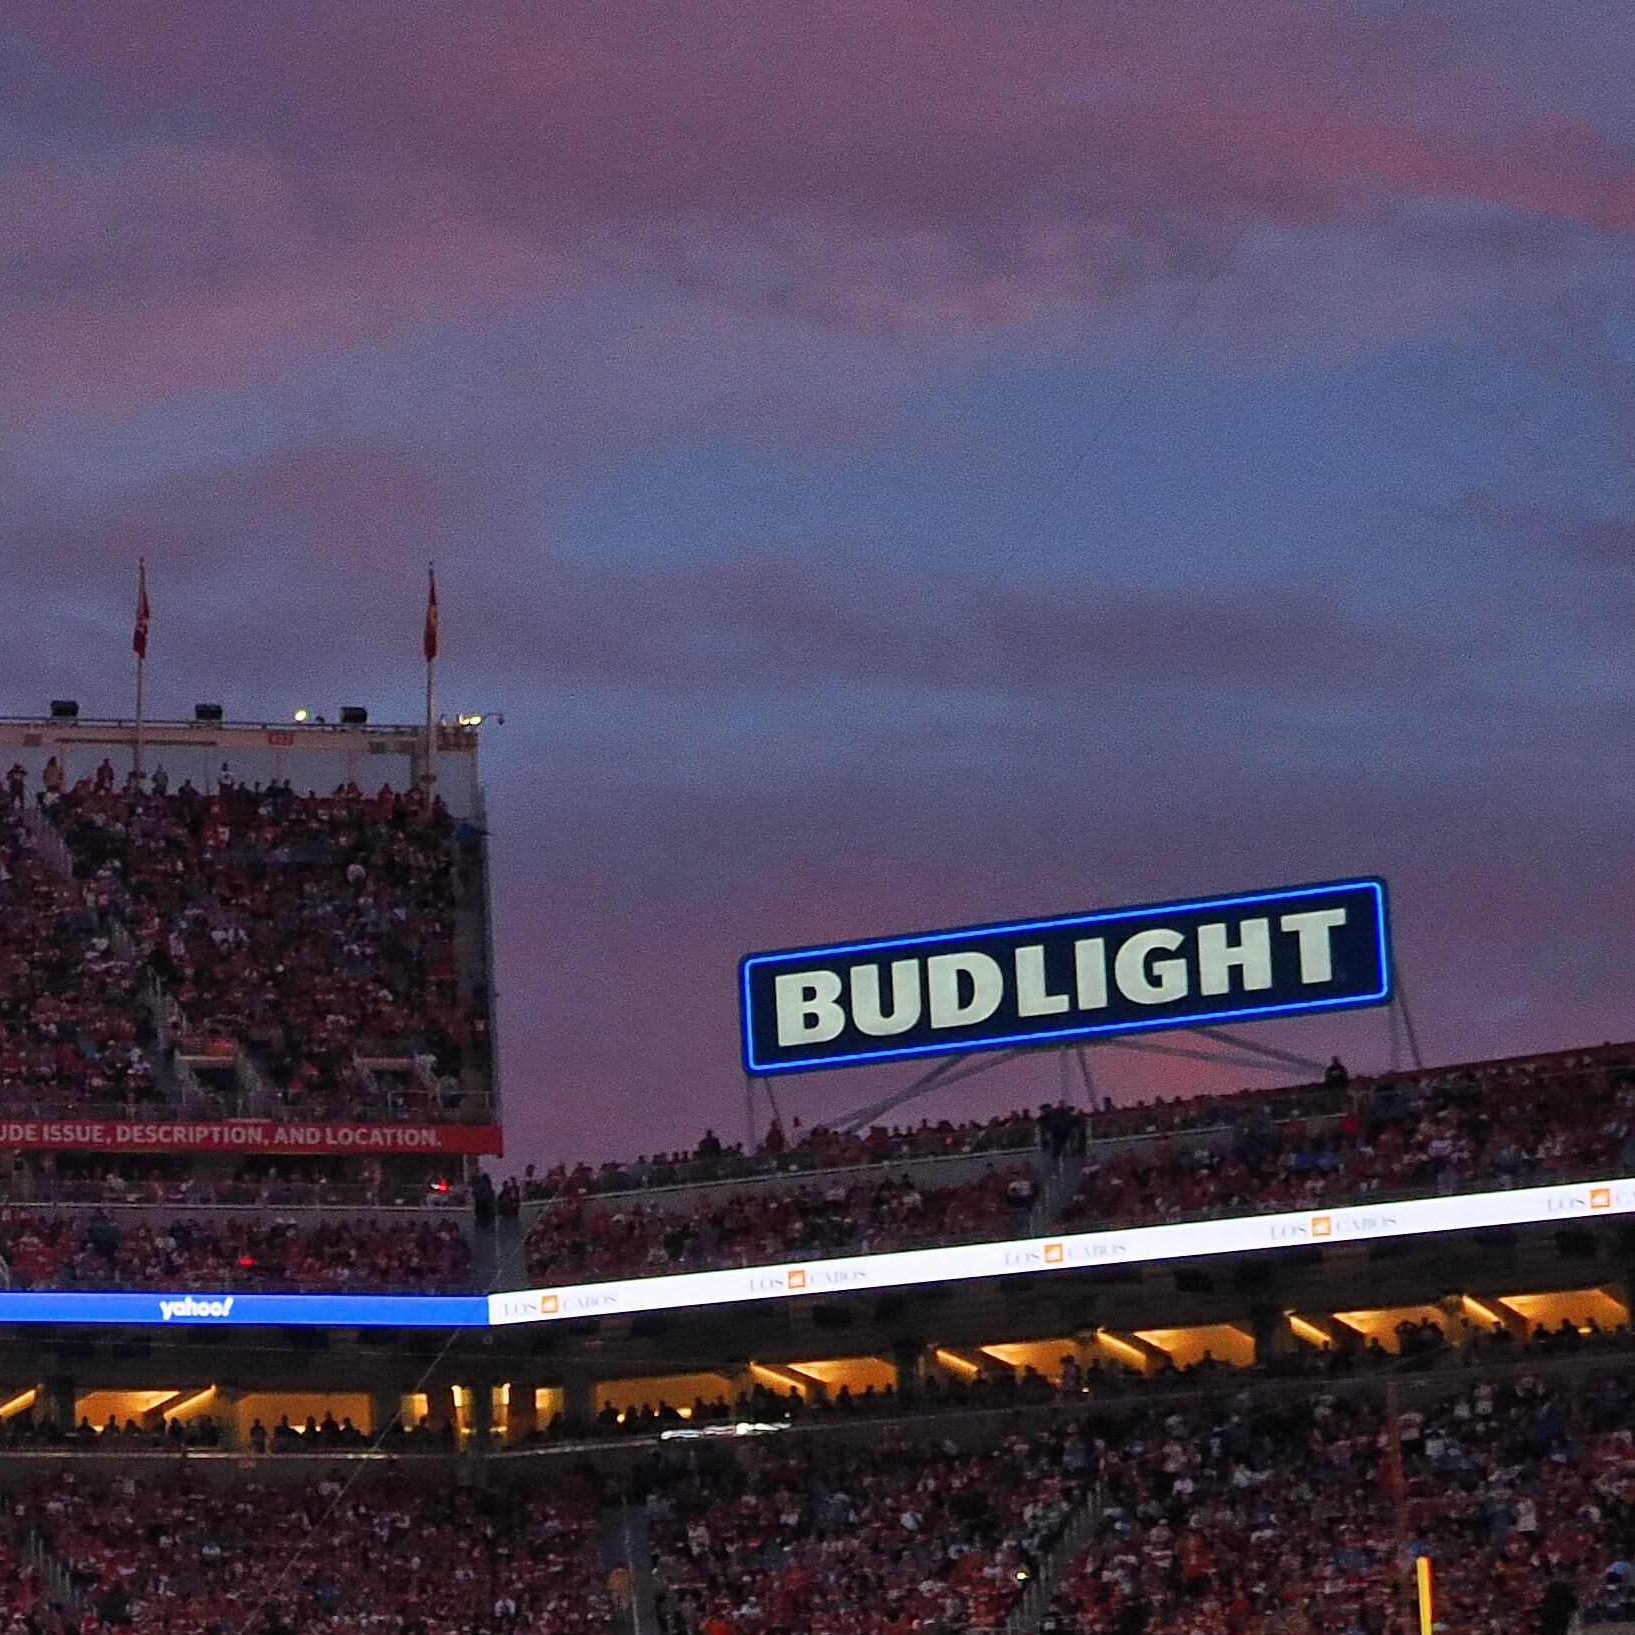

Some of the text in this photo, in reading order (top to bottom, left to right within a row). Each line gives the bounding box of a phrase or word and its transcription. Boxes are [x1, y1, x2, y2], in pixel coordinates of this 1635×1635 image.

[274, 1126, 320, 1144] AND
[326, 1127, 441, 1147] LOCATION.
[1270, 1217, 1397, 1240] LOS CABOS
[1004, 1243, 1127, 1266] LOS CABOS
[749, 1269, 866, 1292] LOS CABOS
[160, 1296, 234, 1320] yahoo!
[504, 1294, 617, 1316] LOS CABOS
